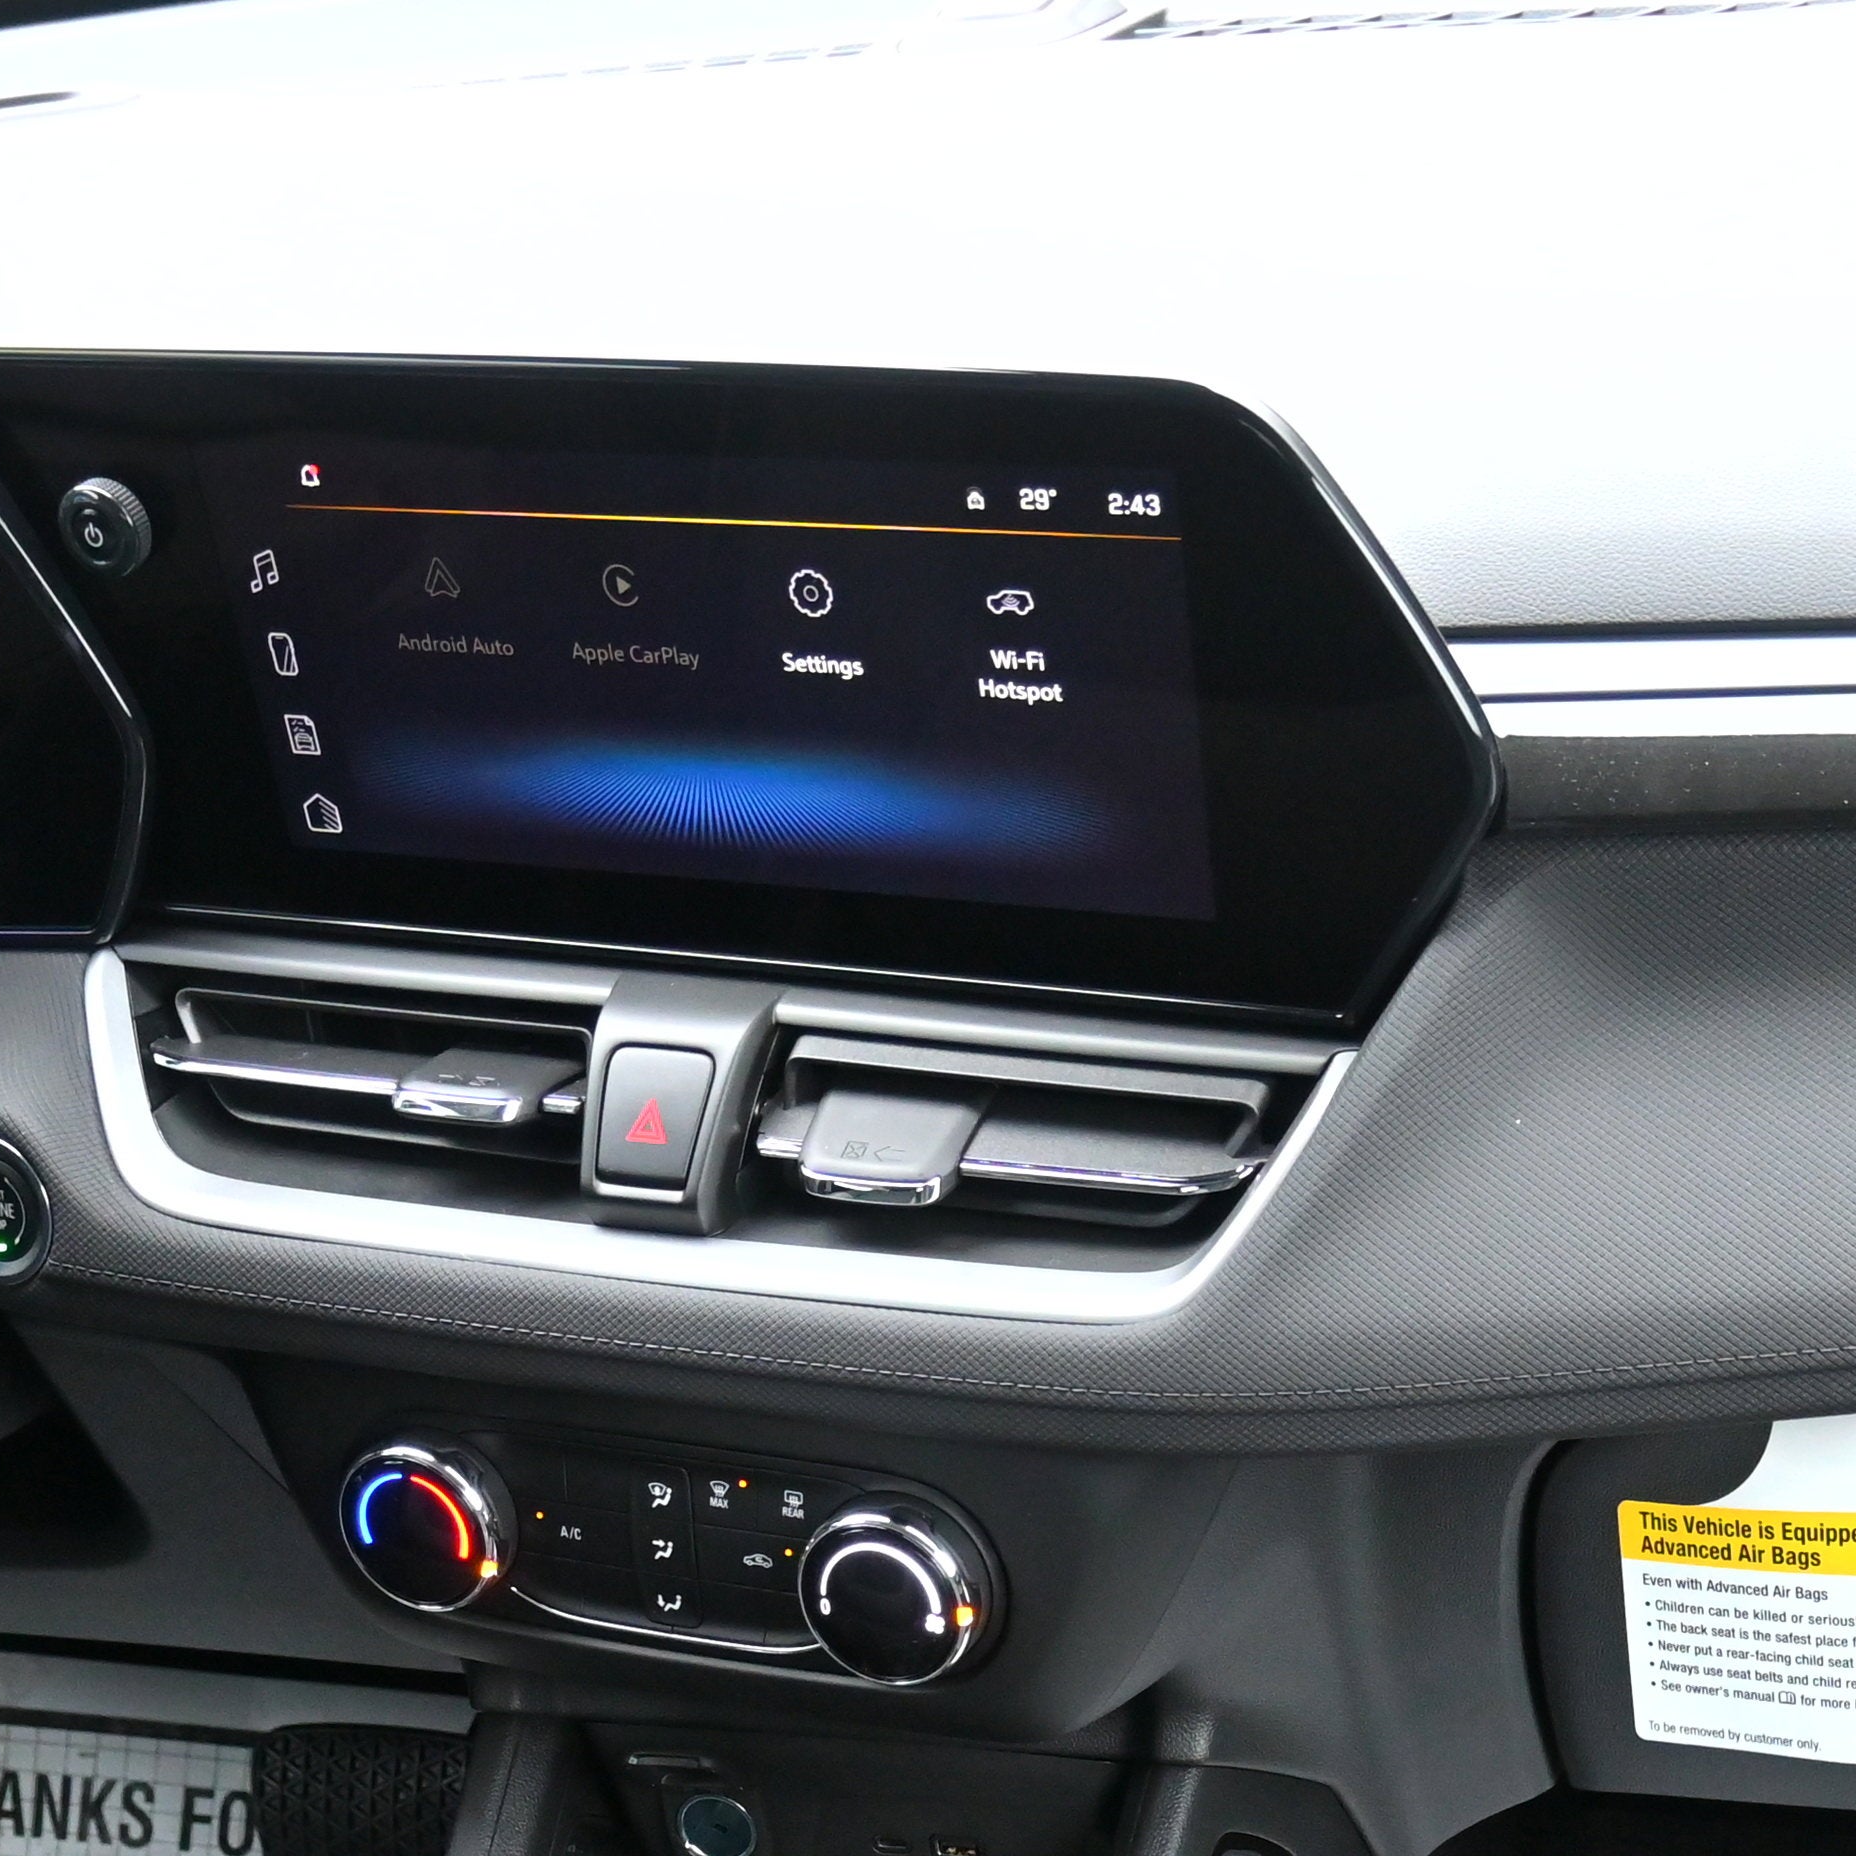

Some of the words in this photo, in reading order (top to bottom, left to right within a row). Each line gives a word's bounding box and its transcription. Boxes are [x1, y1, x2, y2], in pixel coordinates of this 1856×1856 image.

[1108, 492, 1160, 516] 2:43
[398, 632, 468, 654] Android
[472, 637, 515, 656] Auto
[572, 642, 625, 666] Apple
[629, 645, 700, 670] CarPlay
[782, 652, 864, 680] Settings
[990, 649, 1046, 671] Wi-Fi
[978, 678, 1064, 705] Hotspot
[709, 1496, 729, 1509] MAX
[782, 1506, 805, 1520] REAR
[560, 1525, 582, 1541] A/C
[1639, 1511, 1678, 1532] This
[1683, 1515, 1752, 1538] Vehicle
[1758, 1521, 1775, 1540] is
[1641, 1536, 1732, 1561] Advanced
[1738, 1544, 1765, 1563] Air
[1772, 1546, 1821, 1570] Bags
[1643, 1573, 1671, 1588] Even
[1676, 1577, 1702, 1590] with
[1706, 1580, 1769, 1597] Advanced
[1773, 1585, 1791, 1598] Air
[1796, 1586, 1828, 1602] Bags
[1655, 1600, 1704, 1615] Children
[1708, 1606, 1730, 1617] can
[1734, 1605, 1749, 1619] be
[1753, 1609, 1786, 1622] killed
[1791, 1614, 1804, 1624] or
[1656, 1620, 1677, 1632] The
[1680, 1622, 1707, 1636] back
[1712, 1626, 1736, 1638] seat
[1739, 1628, 1749, 1640] is
[1753, 1630, 1771, 1642] the
[1776, 1631, 1812, 1645] safest
[1816, 1636, 1848, 1648] place
[1658, 1640, 1690, 1654] Never
[1694, 1646, 1713, 1657] put
[1716, 1648, 1722, 1658] a
[1726, 1649, 1792, 1666] rear-facing
[1795, 1654, 1824, 1666] child
[1828, 1658, 1854, 1668] seat
[1660, 1660, 1700, 1675] Always
[1703, 1667, 1723, 1677] use
[1727, 1668, 1752, 1680] seat
[1755, 1670, 1784, 1684] belts
[1787, 1674, 1809, 1686] and
[1812, 1676, 1842, 1689] child
[1661, 1680, 1682, 1692] See
[1686, 1684, 1729, 1698] owner's
[1733, 1690, 1775, 1703] manual
[1800, 1695, 1816, 1706] for
[1820, 1699, 1850, 1710] more
[1649, 1720, 1660, 1732] To
[1663, 1722, 1676, 1734] be
[1680, 1726, 1725, 1740] removed
[1728, 1730, 1741, 1742] by
[1744, 1733, 1794, 1748] customer
[1796, 1738, 1822, 1752] only.
[179, 1786, 256, 1856] FO
